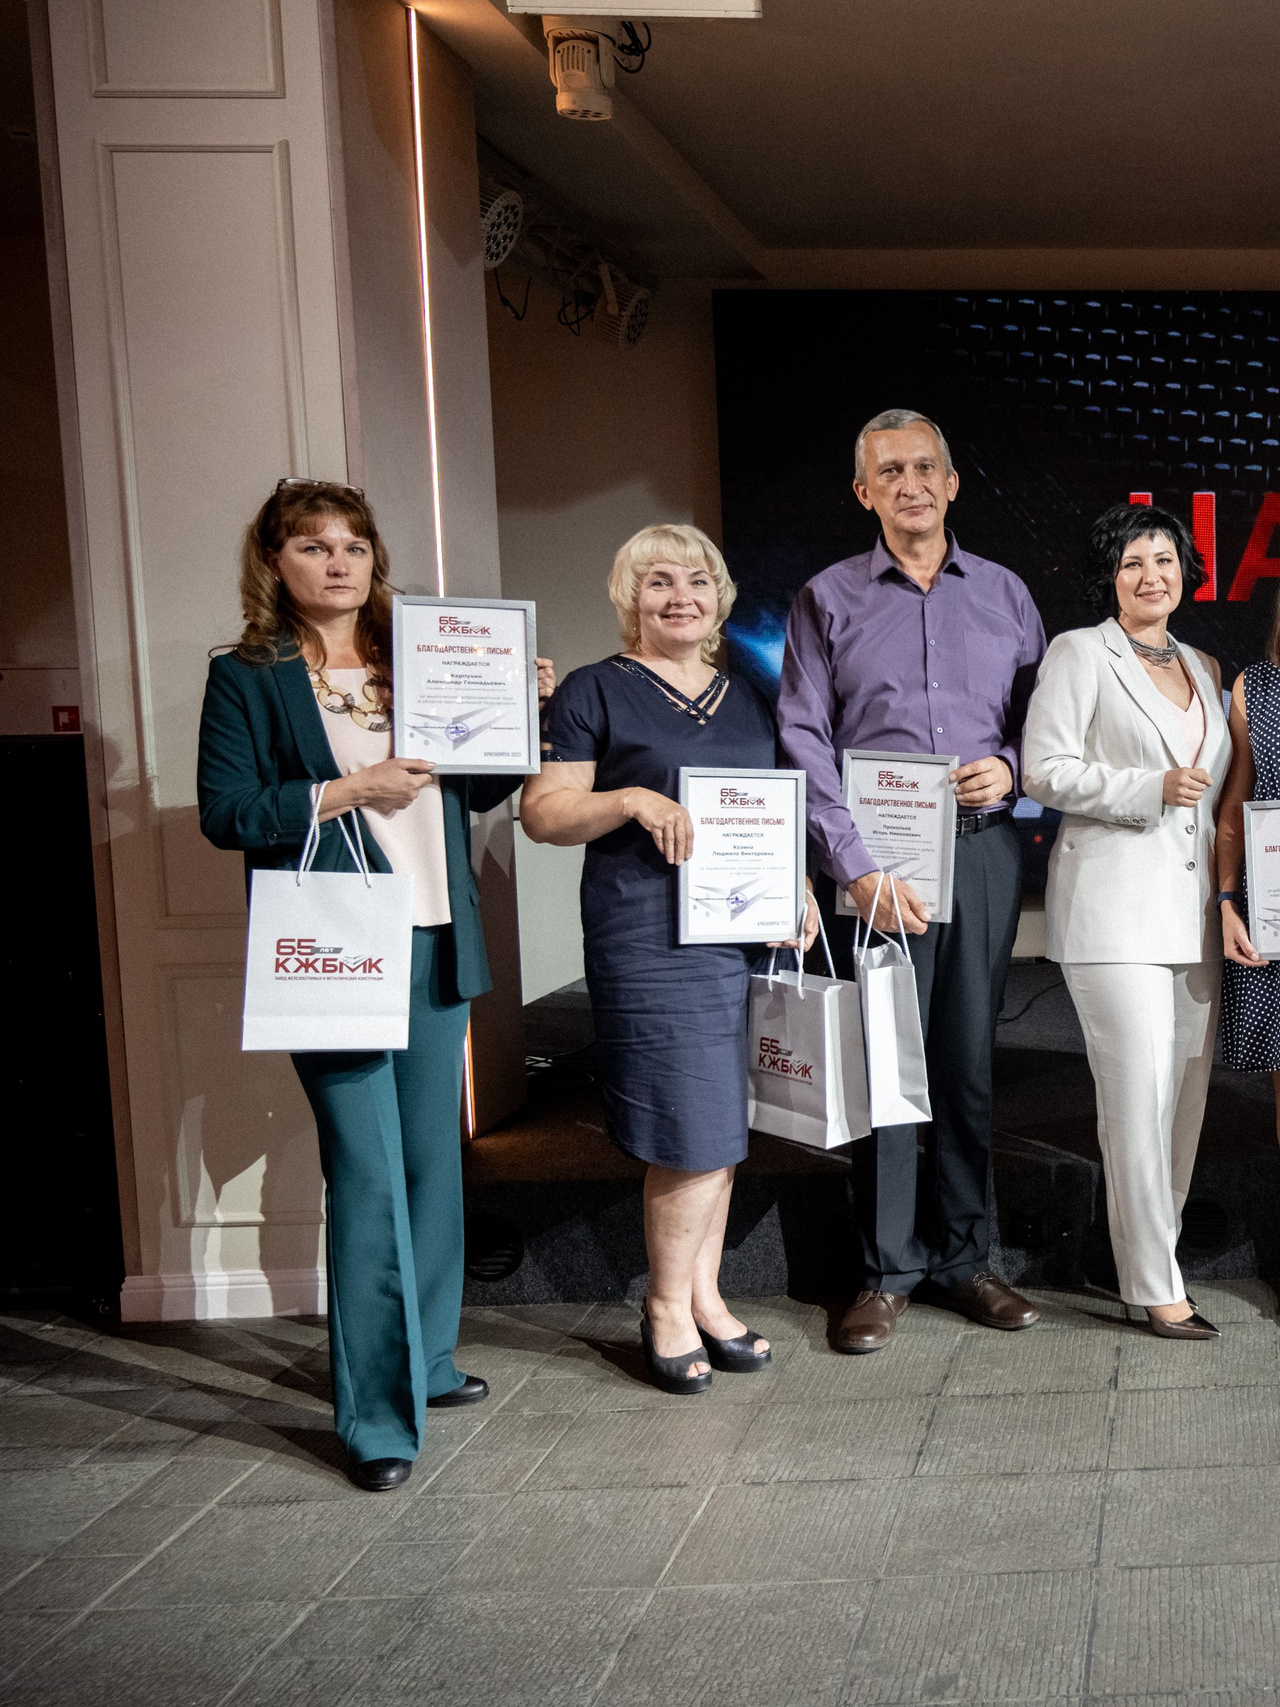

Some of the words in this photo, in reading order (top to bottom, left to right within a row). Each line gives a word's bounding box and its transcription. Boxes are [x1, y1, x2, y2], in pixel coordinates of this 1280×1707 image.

[439, 616, 458, 625] 65
[439, 625, 490, 635] КЖБМК
[487, 646, 512, 655] ПИСЬМО
[878, 780, 919, 789] КЖБМК
[860, 798, 914, 809] БЛАГОДАРСТВЕННОЕ
[915, 801, 936, 809] ПИСЬМО
[276, 938, 316, 956] 65
[275, 958, 384, 973] КЖБМК
[760, 1037, 779, 1055] 65
[759, 1053, 813, 1079] КЖБМК
